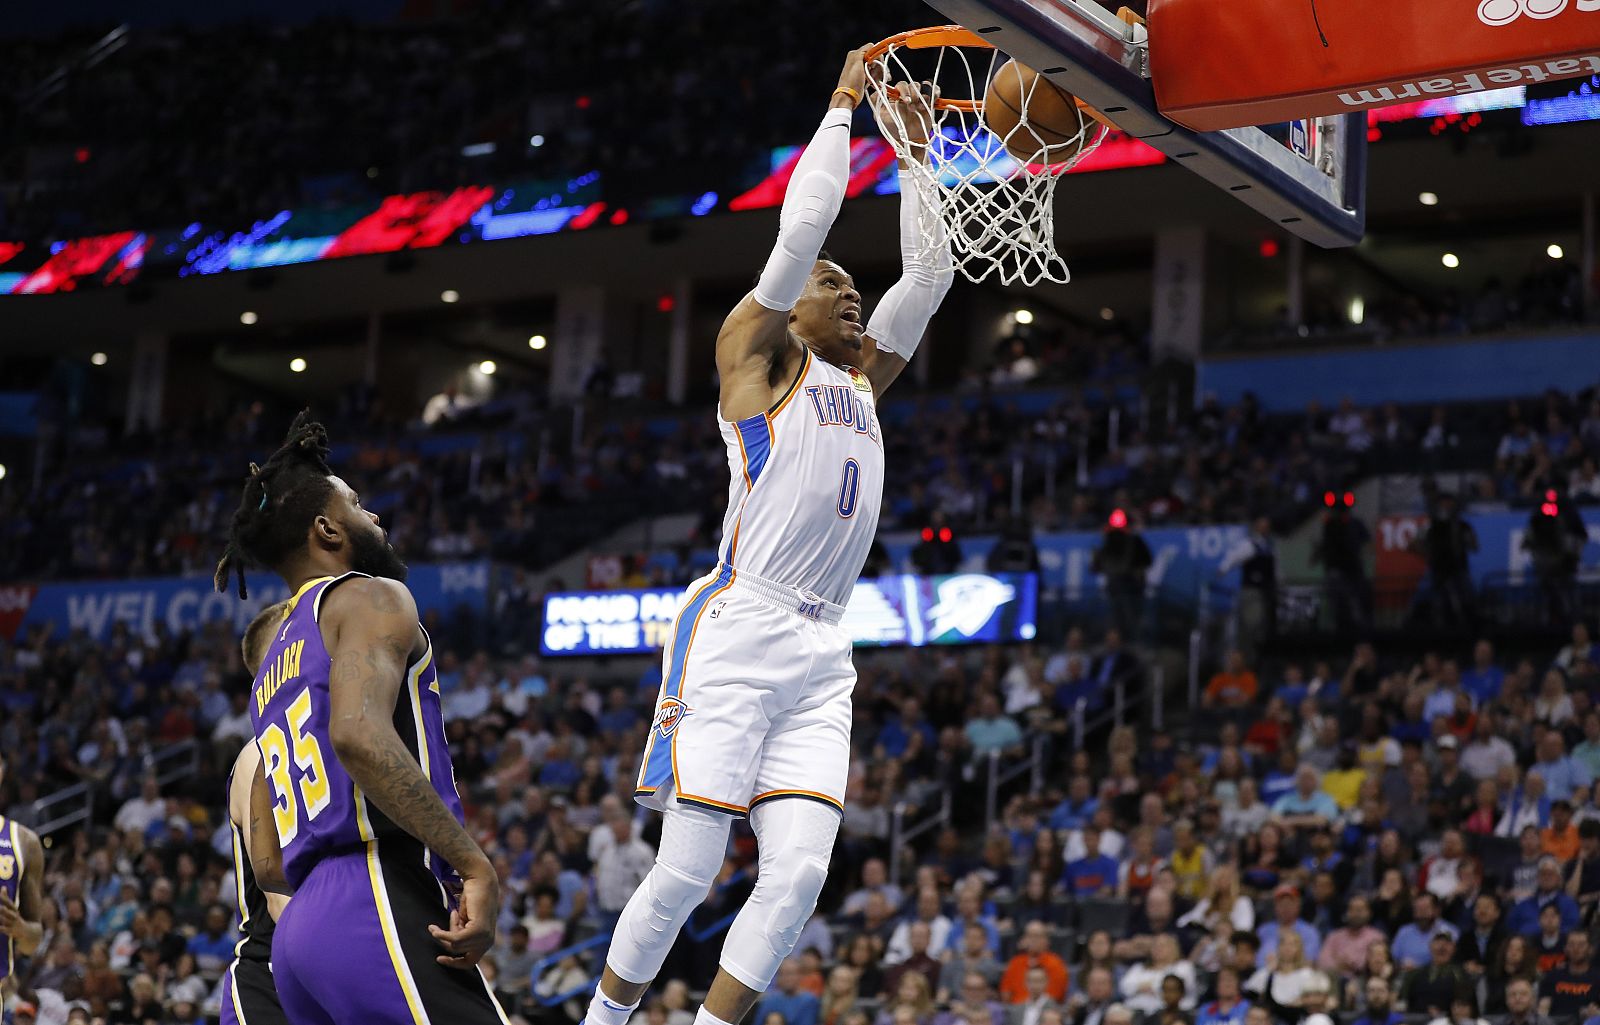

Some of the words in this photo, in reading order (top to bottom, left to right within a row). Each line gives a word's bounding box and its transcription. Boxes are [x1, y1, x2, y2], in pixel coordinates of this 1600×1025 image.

[805, 384, 882, 448] THUDE
[837, 458, 860, 518] 0
[544, 624, 584, 650] OF
[586, 622, 639, 649] THE
[546, 595, 639, 624] PROUD
[255, 639, 305, 718] BULLOCK
[257, 686, 331, 849] 35
